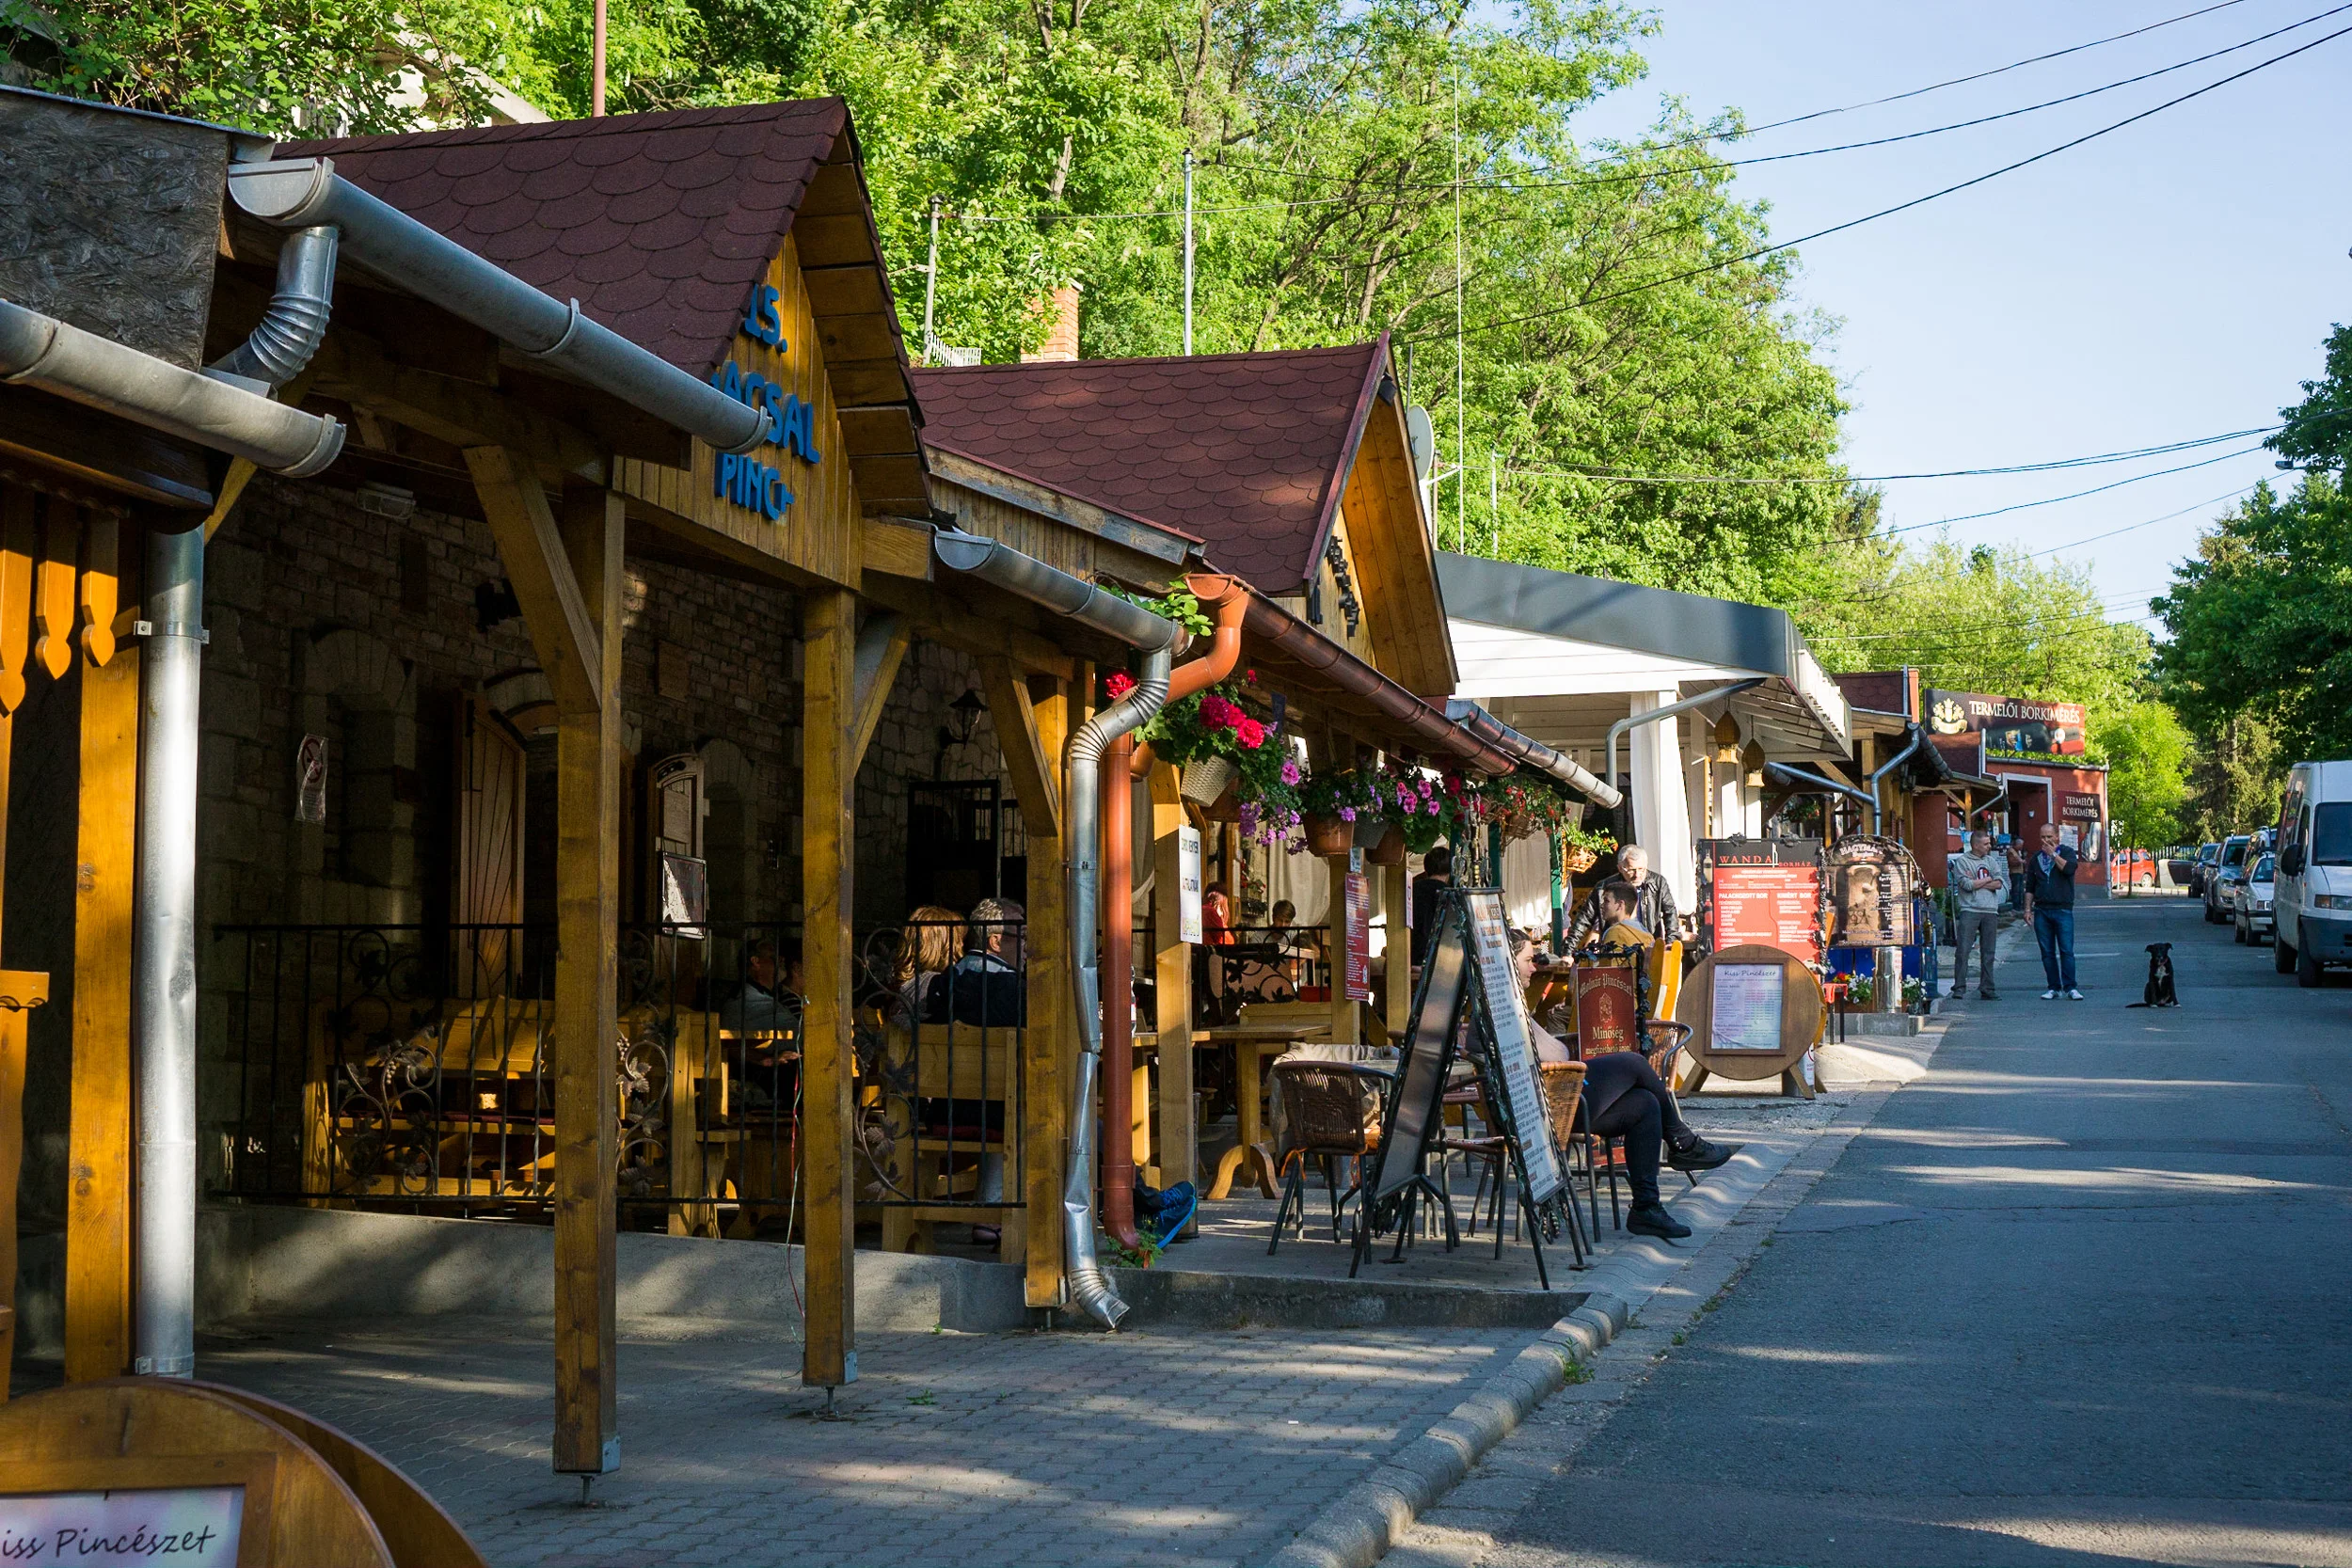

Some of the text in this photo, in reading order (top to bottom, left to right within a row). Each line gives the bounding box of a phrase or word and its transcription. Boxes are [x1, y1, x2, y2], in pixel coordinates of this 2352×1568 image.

[1969, 701, 2080, 723] TERMELŐI BORKIMÉRÉS
[2065, 796, 2094, 807] TERMELŐI
[2062, 807, 2098, 818] BORKIMÉRÉS
[1720, 855, 1772, 863] WANDA
[1593, 1025, 1624, 1042] Minőség
[1, 1525, 216, 1559] iss Pincészet
